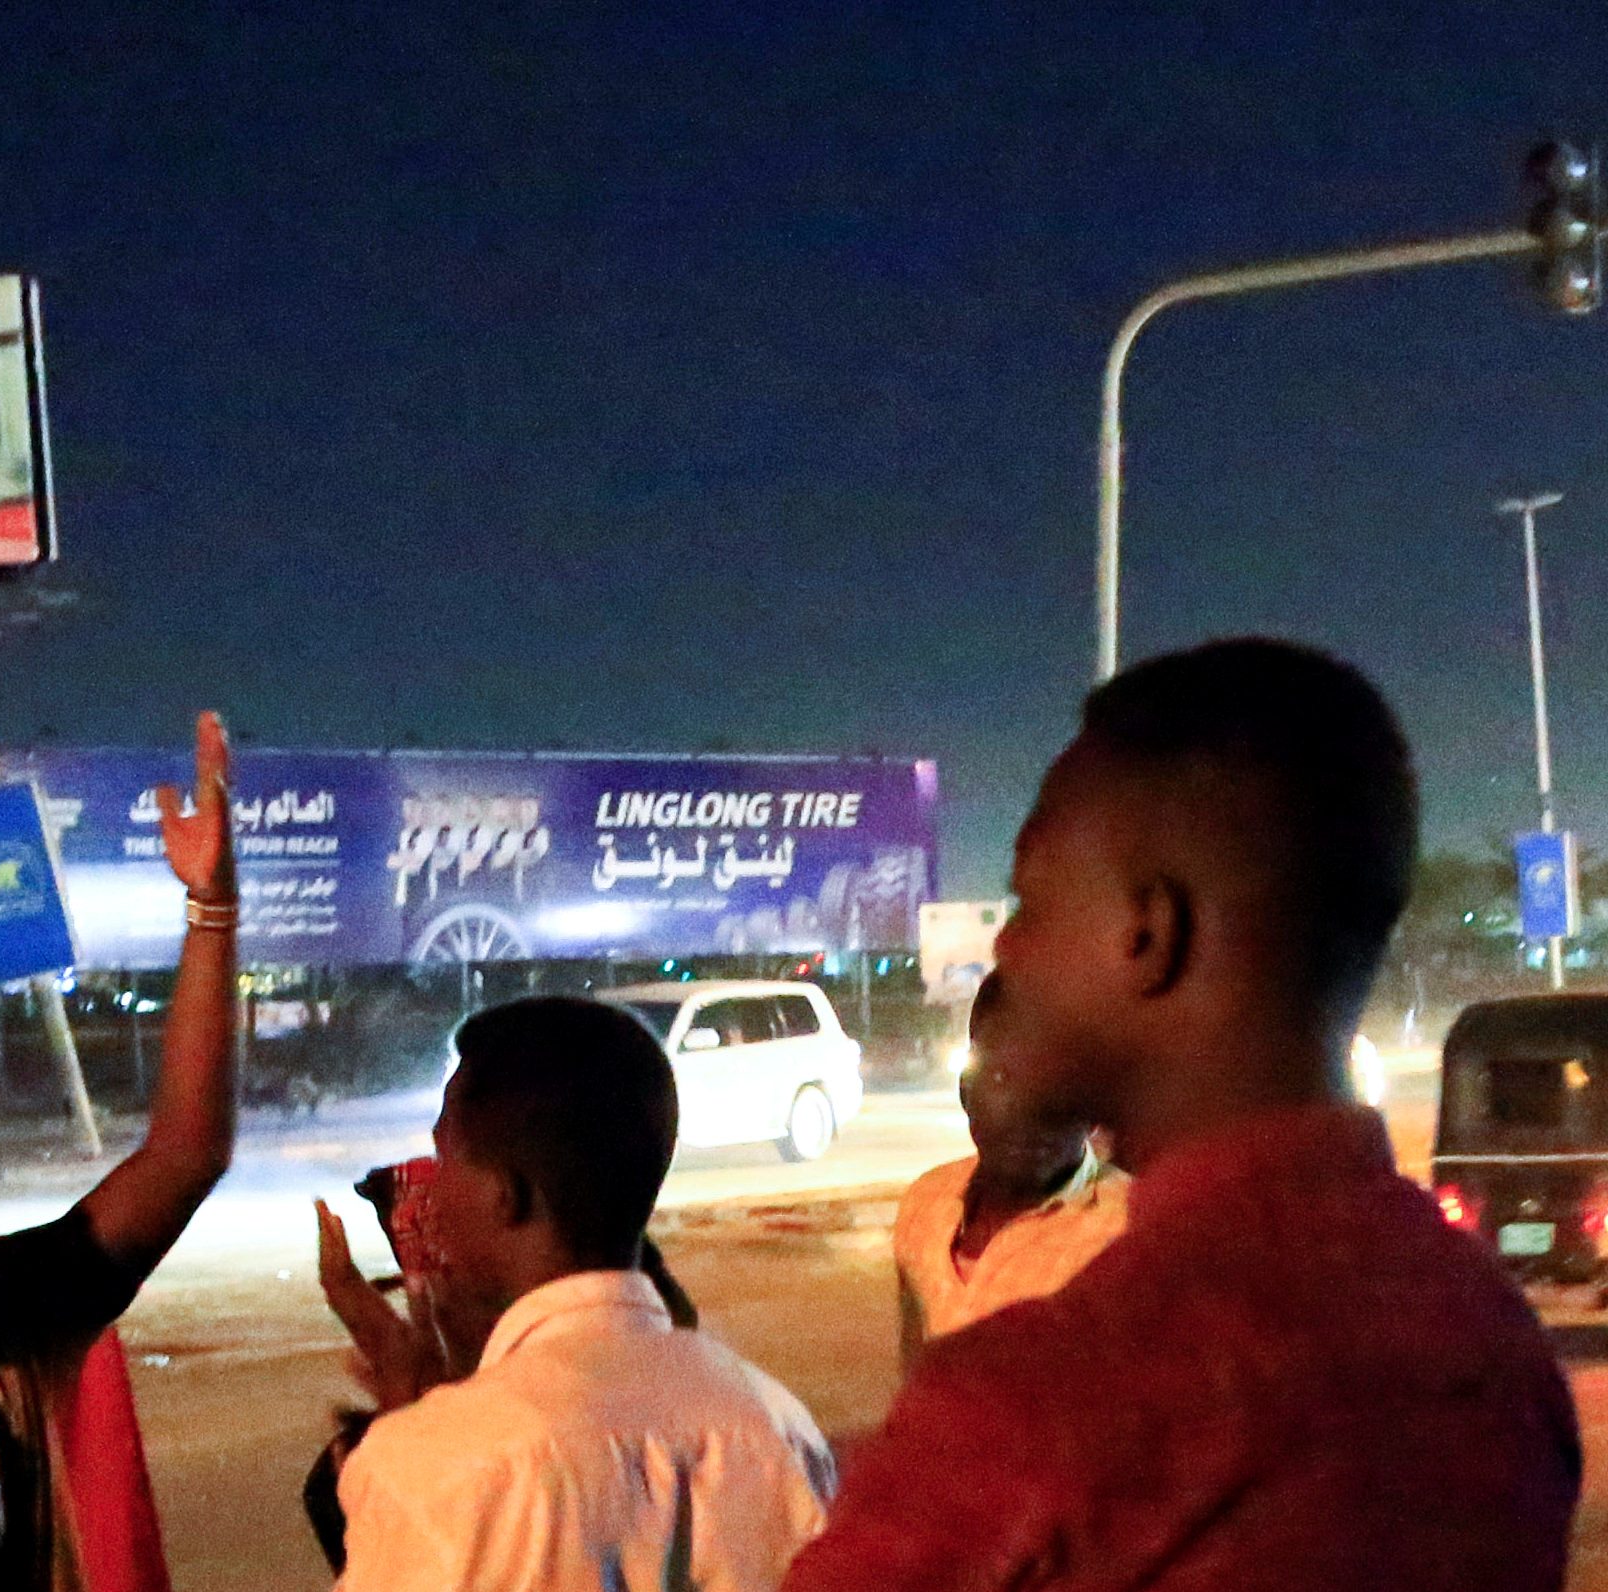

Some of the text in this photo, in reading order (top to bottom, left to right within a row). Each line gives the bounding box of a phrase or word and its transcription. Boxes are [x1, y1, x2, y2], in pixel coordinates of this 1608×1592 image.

[265, 790, 334, 829] العالم
[595, 791, 862, 828] LINGLONG TIRE
[123, 836, 155, 856] THE
[241, 836, 284, 855] YOUR
[286, 835, 340, 854] REACH
[593, 832, 708, 890] لونق
